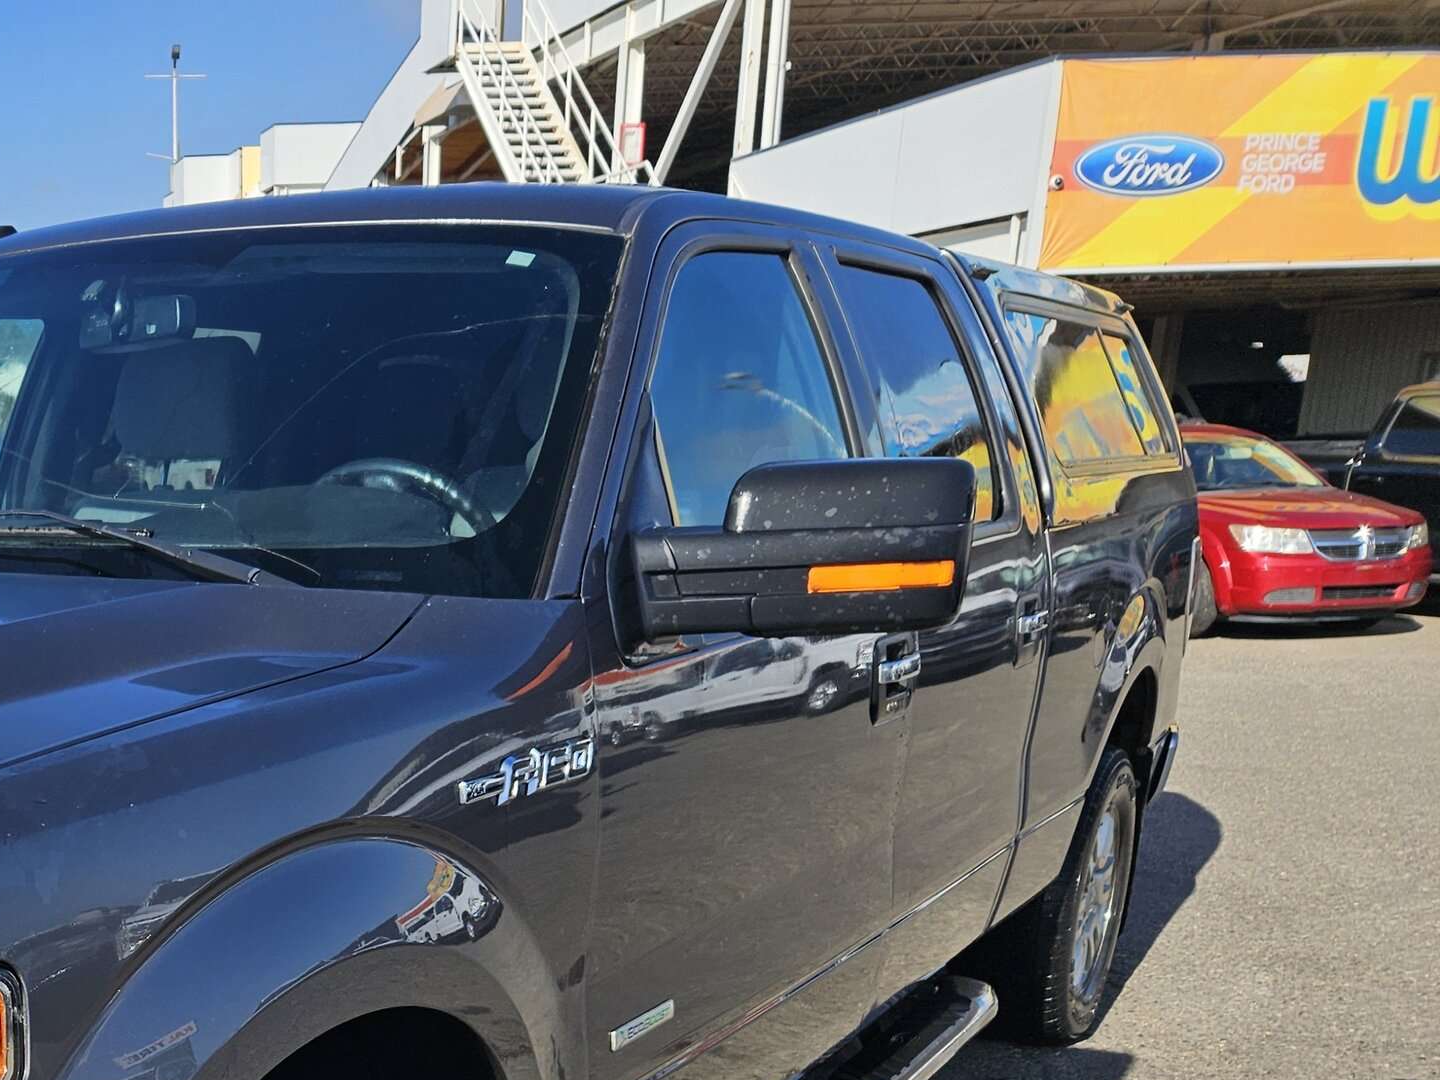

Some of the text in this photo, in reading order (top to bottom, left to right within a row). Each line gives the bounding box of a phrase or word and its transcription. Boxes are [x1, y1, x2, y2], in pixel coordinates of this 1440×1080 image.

[1244, 133, 1322, 151] PRINCE
[1102, 142, 1198, 187] Ford
[1240, 152, 1326, 172] GEORGE
[1236, 174, 1296, 193] FORD
